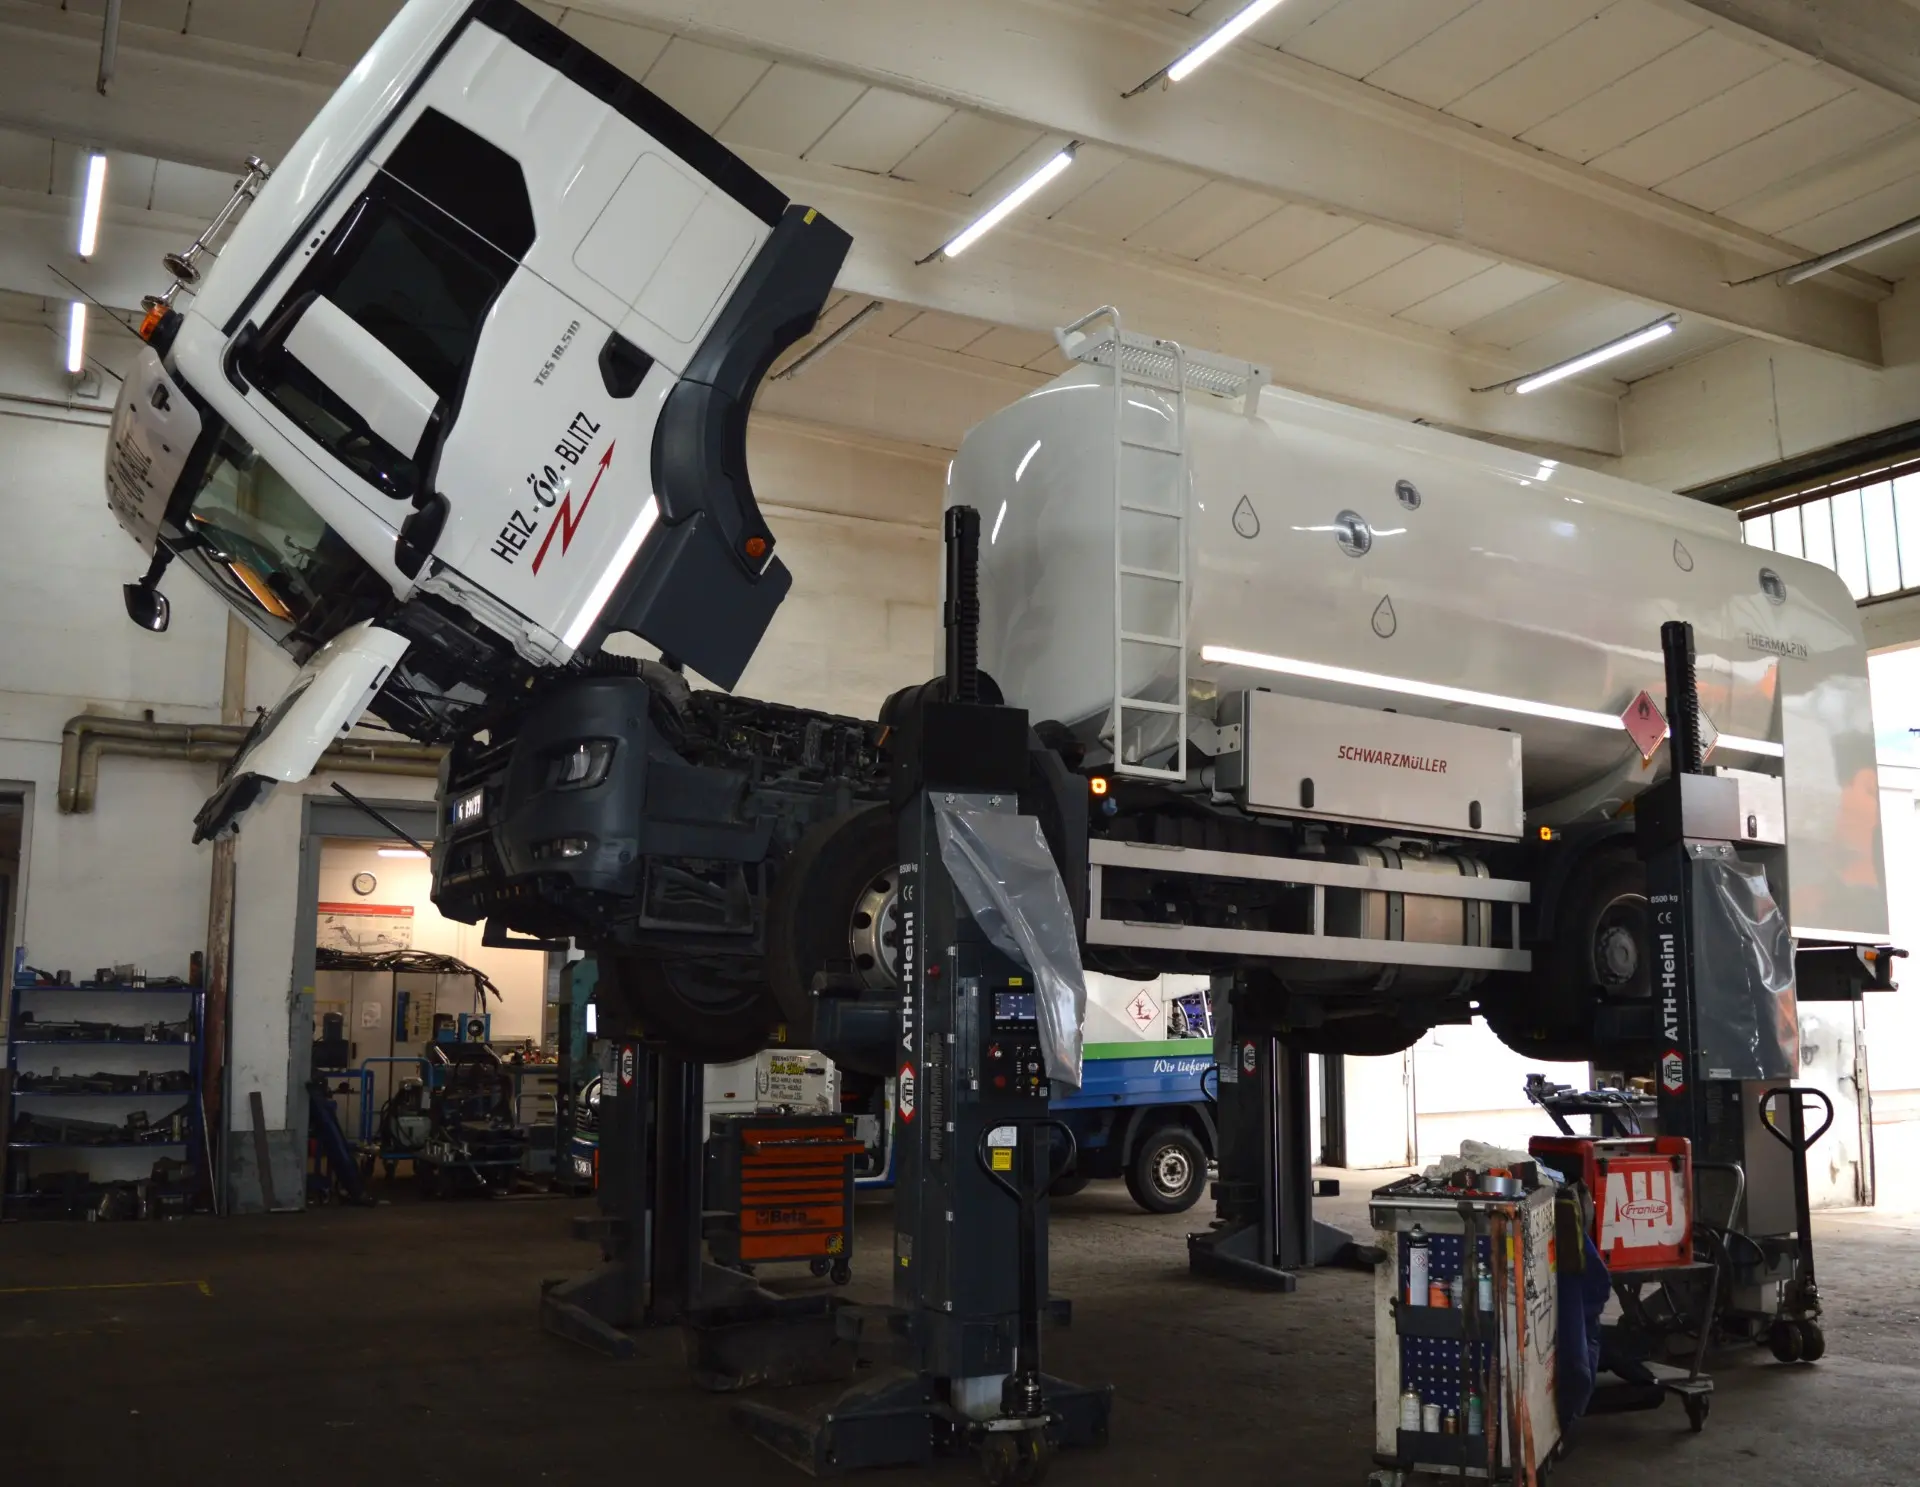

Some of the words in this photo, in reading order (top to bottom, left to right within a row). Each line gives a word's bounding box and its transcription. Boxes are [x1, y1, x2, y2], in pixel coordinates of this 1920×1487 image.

[1745, 632, 1808, 658] THERMALPIN
[1337, 745, 1447, 774] SCHWARZMÜLLER
[1669, 894, 1679, 903] kg
[903, 911, 914, 1053] ATH-Heinl
[1659, 933, 1679, 1042] ATH-Heinl
[1153, 1059, 1175, 1074] Wir
[771, 1208, 807, 1225] Beta
[1600, 1170, 1687, 1251] ALU
[1626, 1204, 1665, 1216] Fronius
